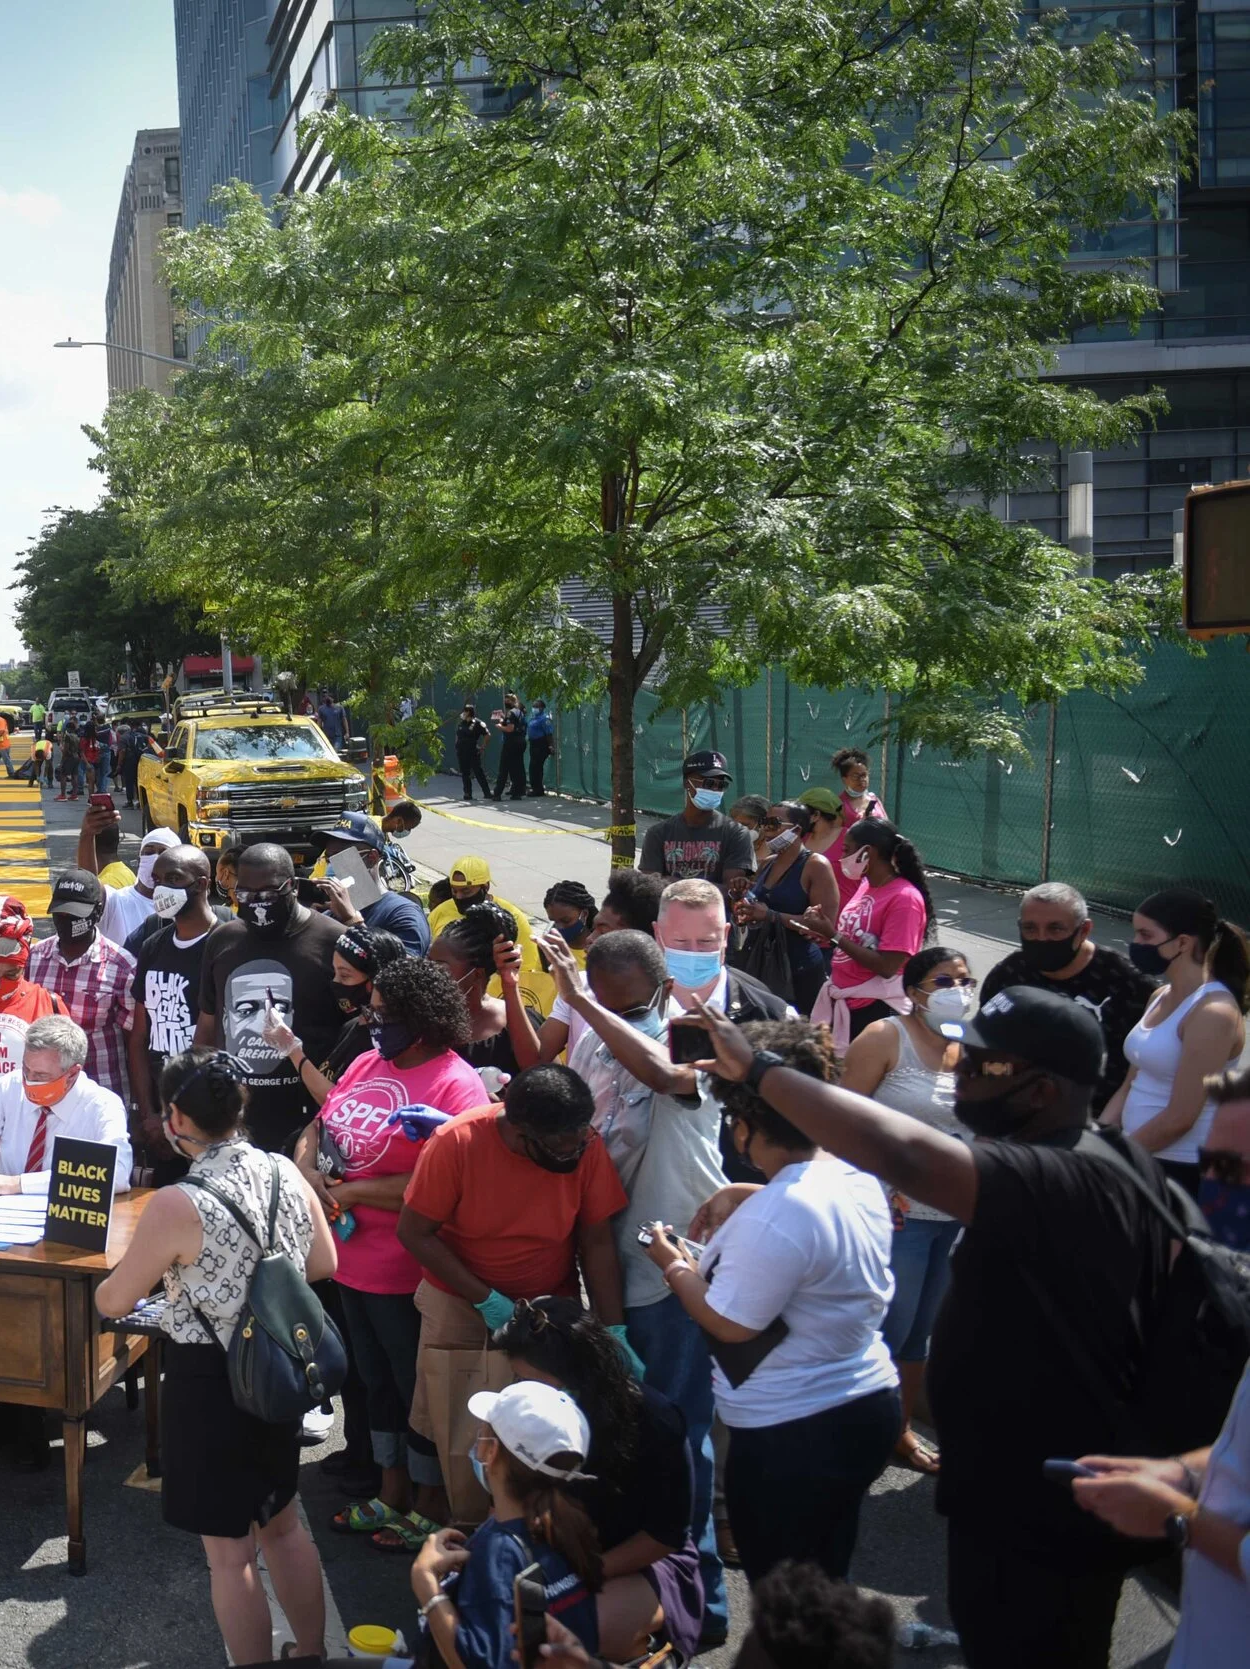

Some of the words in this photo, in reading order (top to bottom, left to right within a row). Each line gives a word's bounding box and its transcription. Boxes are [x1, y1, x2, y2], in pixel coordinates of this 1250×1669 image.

[145, 970, 190, 1010] BLACK
[157, 1000, 190, 1027] LIVES
[238, 1036, 246, 1045] I
[248, 1078, 281, 1086] GEORGE
[283, 1077, 299, 1085] FLO
[57, 1160, 108, 1182] BLACK
[58, 1182, 101, 1203] LIVES
[47, 1203, 108, 1228] MATTER
